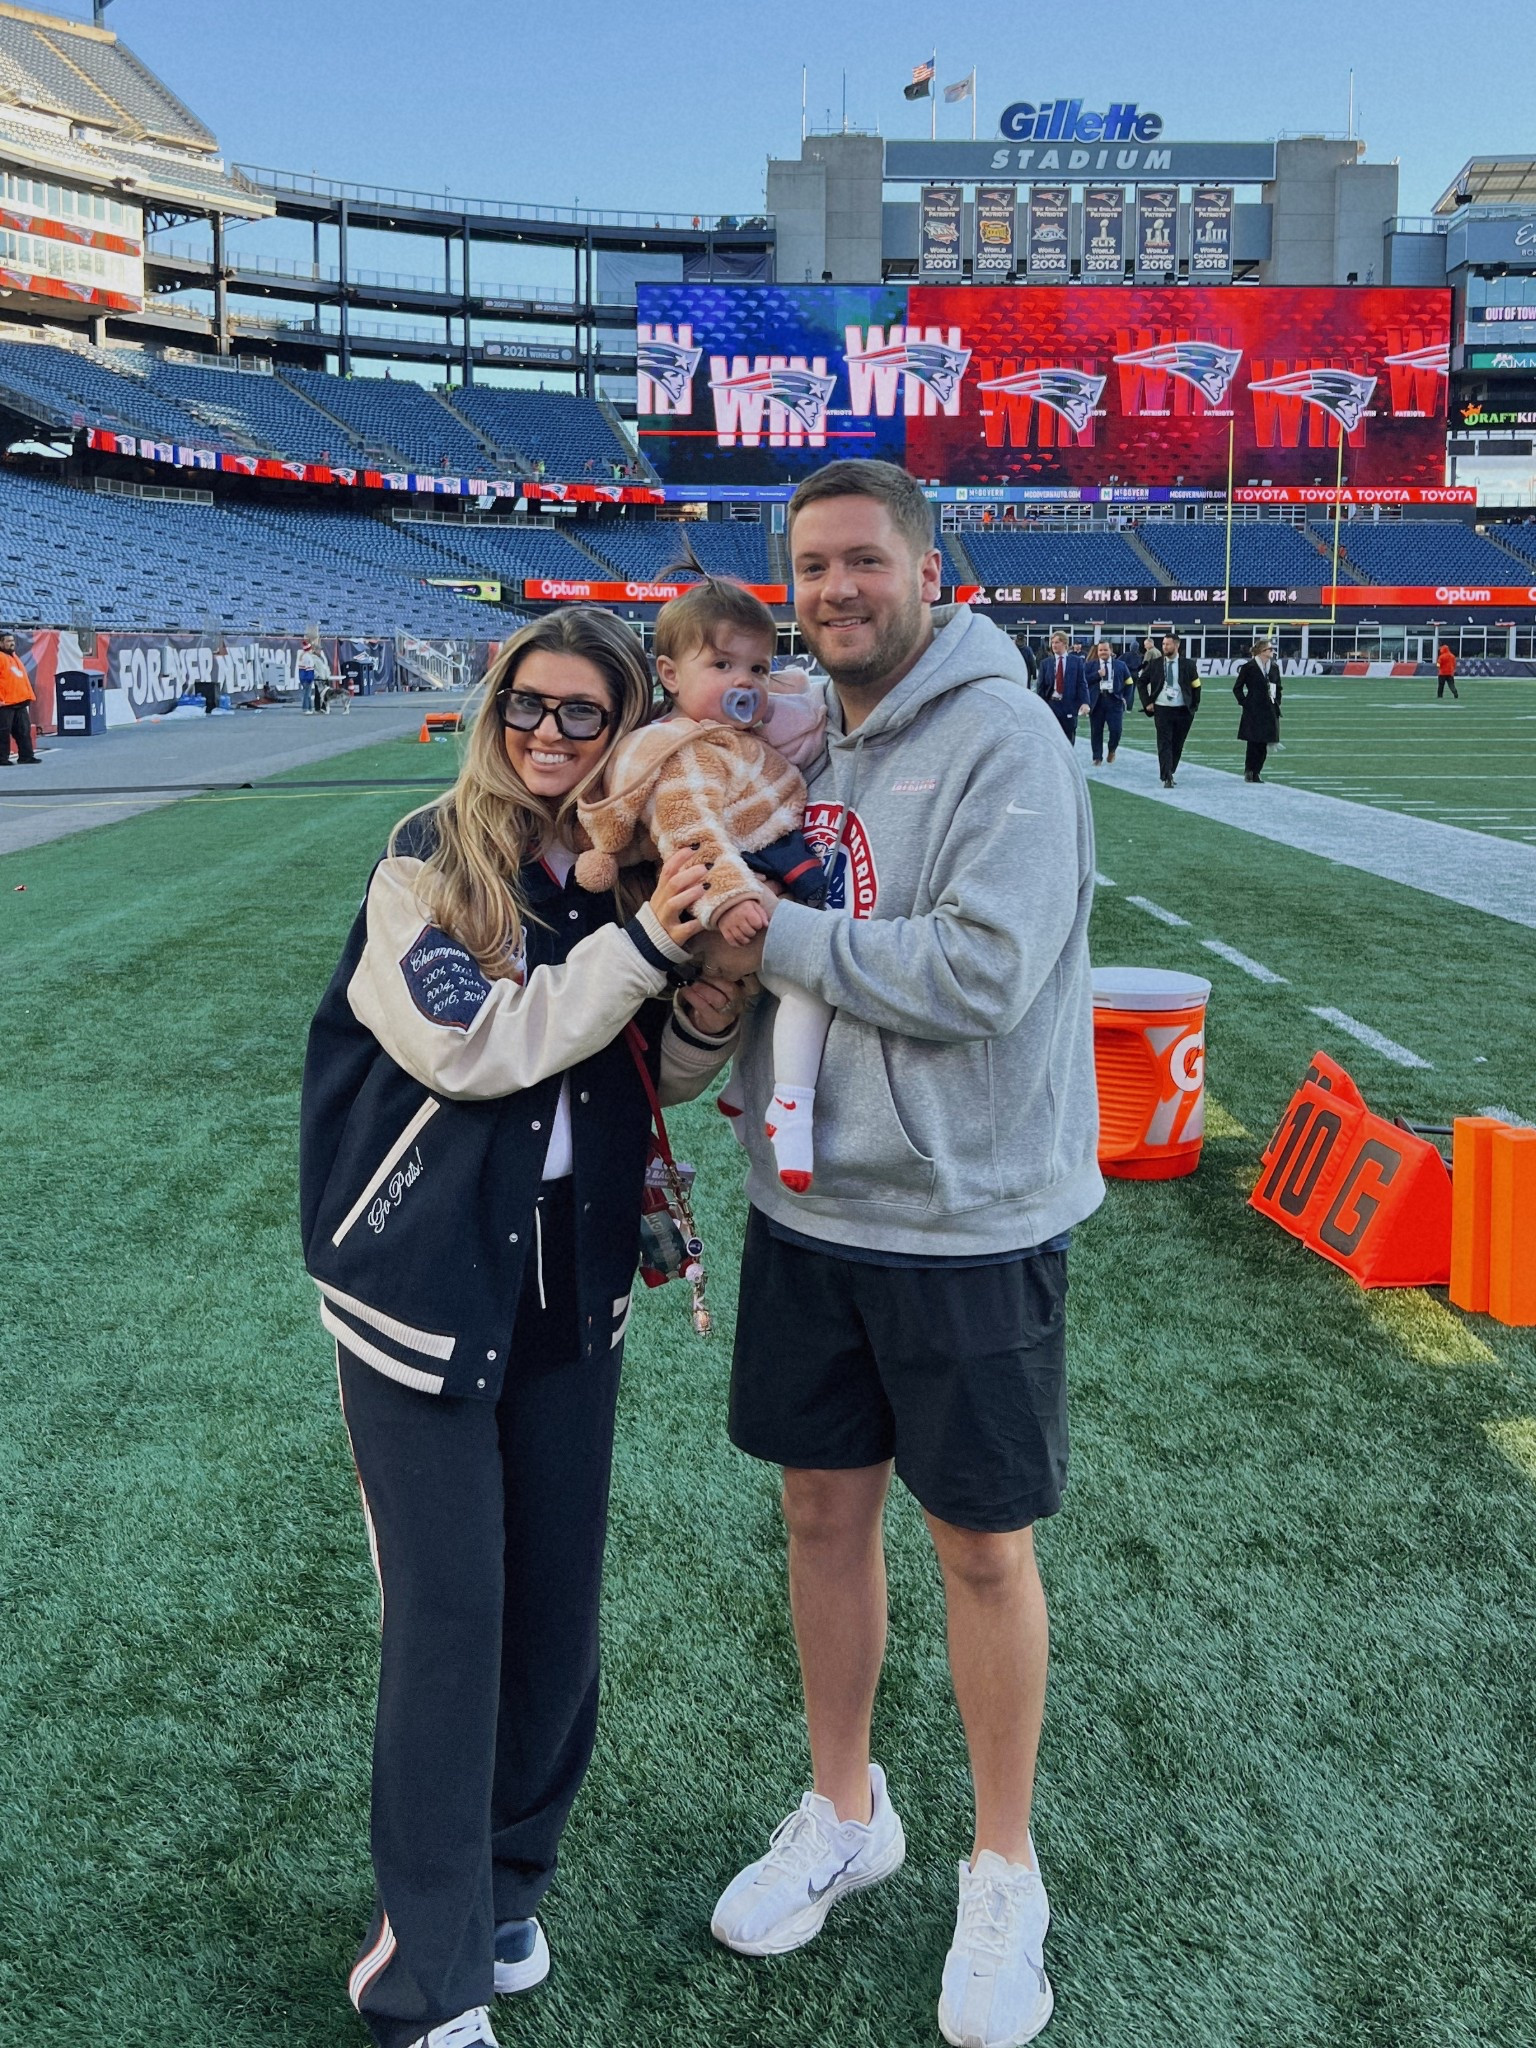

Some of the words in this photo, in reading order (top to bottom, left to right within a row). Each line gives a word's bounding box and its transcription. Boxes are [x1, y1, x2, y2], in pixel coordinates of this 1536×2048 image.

[1000, 98, 1164, 143] Gillette
[991, 150, 1171, 170] STADIUM
[1091, 239, 1116, 247] XLIX
[925, 260, 957, 269] 2001
[977, 260, 1012, 269] 2003
[1031, 260, 1066, 269] 2004
[1087, 261, 1118, 270] 2014
[1141, 260, 1173, 270] 2016
[1195, 260, 1227, 269] 2018
[1485, 307, 1502, 320] OUT
[1504, 307, 1517, 320] OF
[503, 345, 528, 358] 2021
[529, 351, 560, 360] WINNERS
[845, 325, 962, 416] WIN
[1116, 328, 1233, 416] WIN
[709, 356, 826, 447] WIN
[979, 357, 1098, 448] WIN
[1250, 358, 1367, 448] WIN
[1235, 489, 1289, 501] TOYOTA
[1298, 489, 1351, 501] TOYOTA
[1356, 489, 1410, 501] TOYOTA
[1419, 489, 1474, 502] TOYOTA
[541, 580, 590, 598] Optum
[625, 582, 678, 600] Optum
[995, 588, 1021, 601] CLE
[1040, 588, 1056, 601] 13
[1435, 586, 1491, 604] Optum
[1083, 590, 1111, 602] 4TH
[1113, 590, 1122, 602] &
[1124, 590, 1138, 602] 13
[1171, 590, 1193, 602] BALL
[1194, 590, 1207, 602] ON
[1212, 590, 1228, 602] 22
[1268, 590, 1287, 603] QTR
[1288, 590, 1298, 602] 4
[1196, 659, 1324, 676] ENGAND
[119, 646, 213, 705] FOREVER
[850, 823, 874, 919] PATRIOT
[410, 947, 470, 972] Champions
[1170, 1030, 1203, 1092] G
[1263, 1101, 1341, 1217] 10
[367, 1197, 391, 1234] Go
[388, 1145, 424, 1207] Pats!
[1319, 1138, 1402, 1257] G
